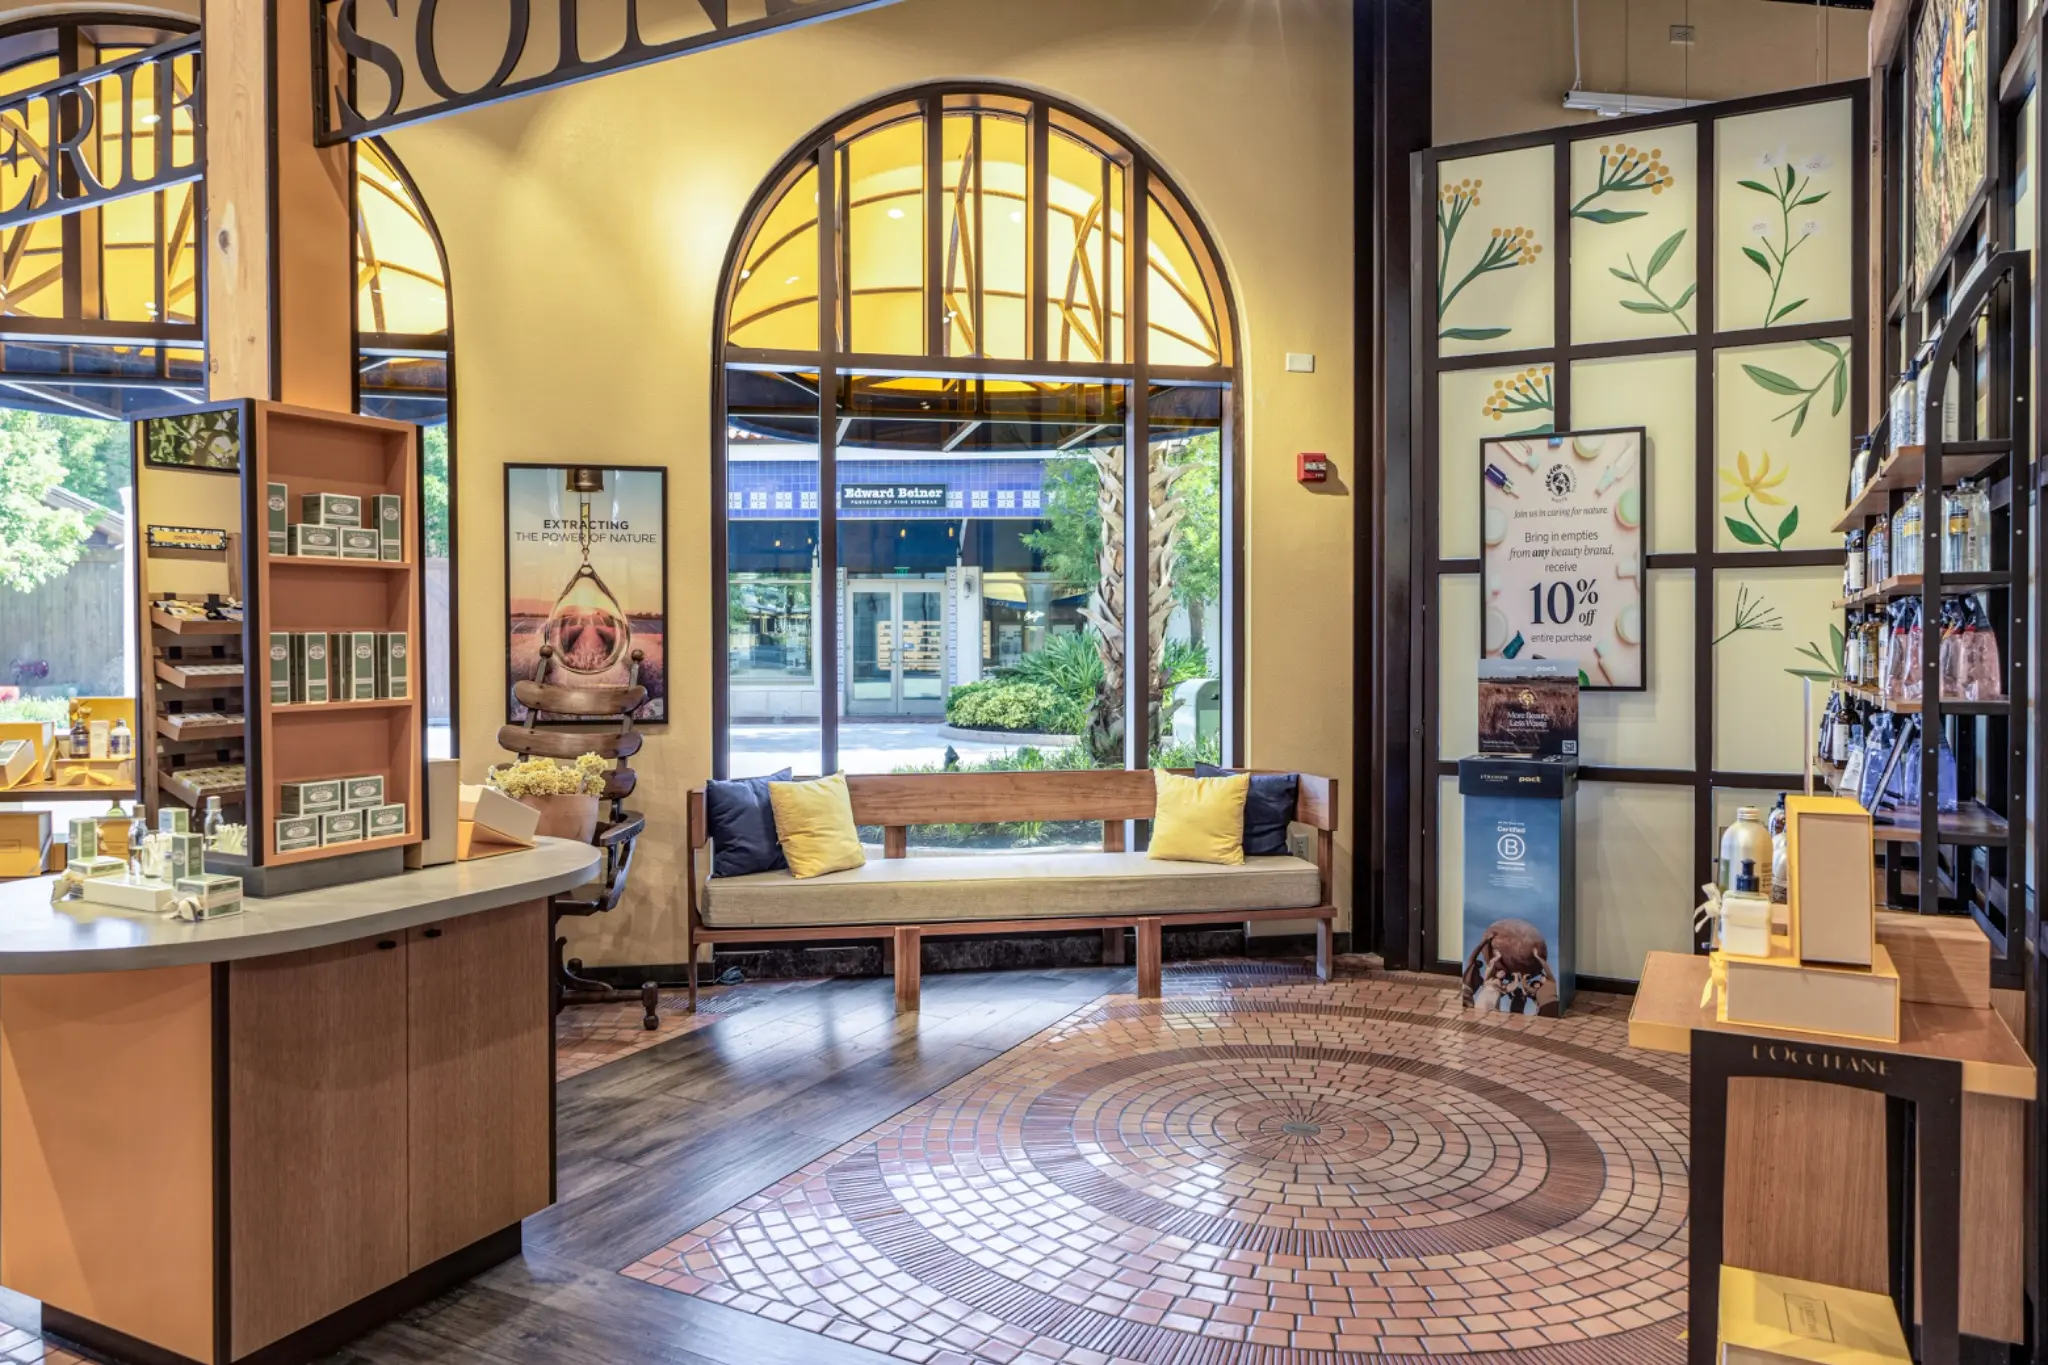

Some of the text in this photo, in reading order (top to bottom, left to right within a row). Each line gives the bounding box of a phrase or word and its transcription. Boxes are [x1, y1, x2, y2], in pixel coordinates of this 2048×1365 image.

[335, 0, 835, 124] SOI
[844, 487, 943, 498] Edward Beiner
[1514, 508, 1528, 519] Join
[1539, 508, 1546, 516] in
[1548, 508, 1570, 518] caring
[1570, 507, 1582, 518] for
[543, 519, 630, 530] EXTRACTING
[515, 532, 657, 543] THE POWER OF NATURE
[1525, 531, 1599, 544] Bring in empties
[1509, 545, 1615, 561] from any beauty brand,
[1545, 561, 1578, 572] receive
[1578, 609, 1597, 626] off
[1531, 633, 1592, 644] entire purchase
[1505, 838, 1518, 855] B
